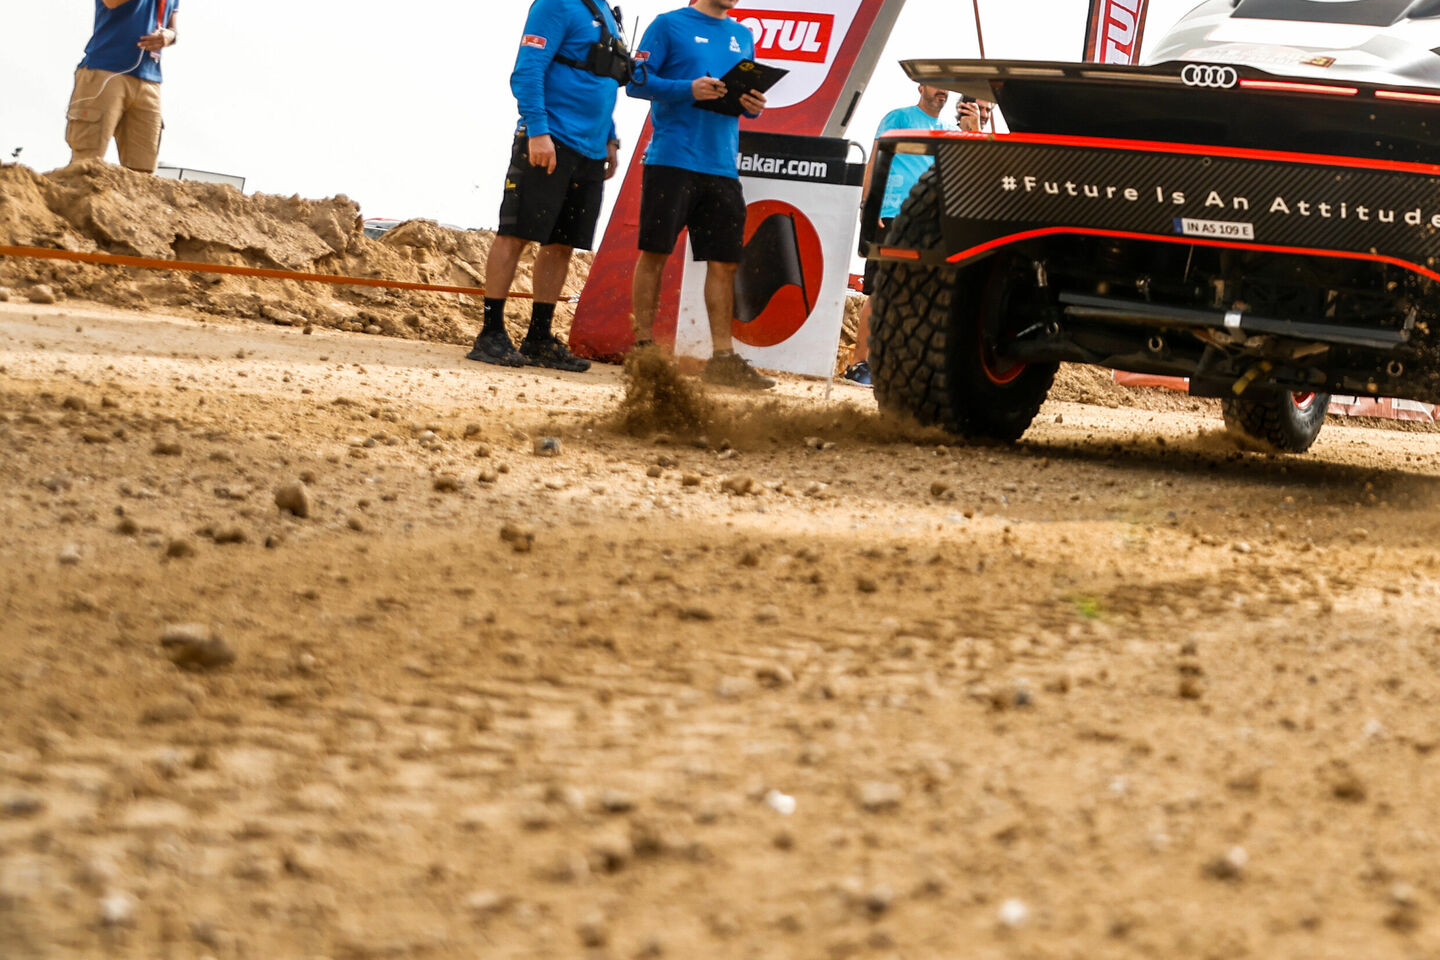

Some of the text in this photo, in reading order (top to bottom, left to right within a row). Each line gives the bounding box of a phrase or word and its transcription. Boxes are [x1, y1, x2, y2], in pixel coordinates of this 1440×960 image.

[732, 17, 822, 52] OTUL
[1002, 176, 1138, 201] #Future
[1156, 186, 1186, 204] Is
[1204, 191, 1250, 210] An
[1187, 222, 1249, 236] IN AS 109 E
